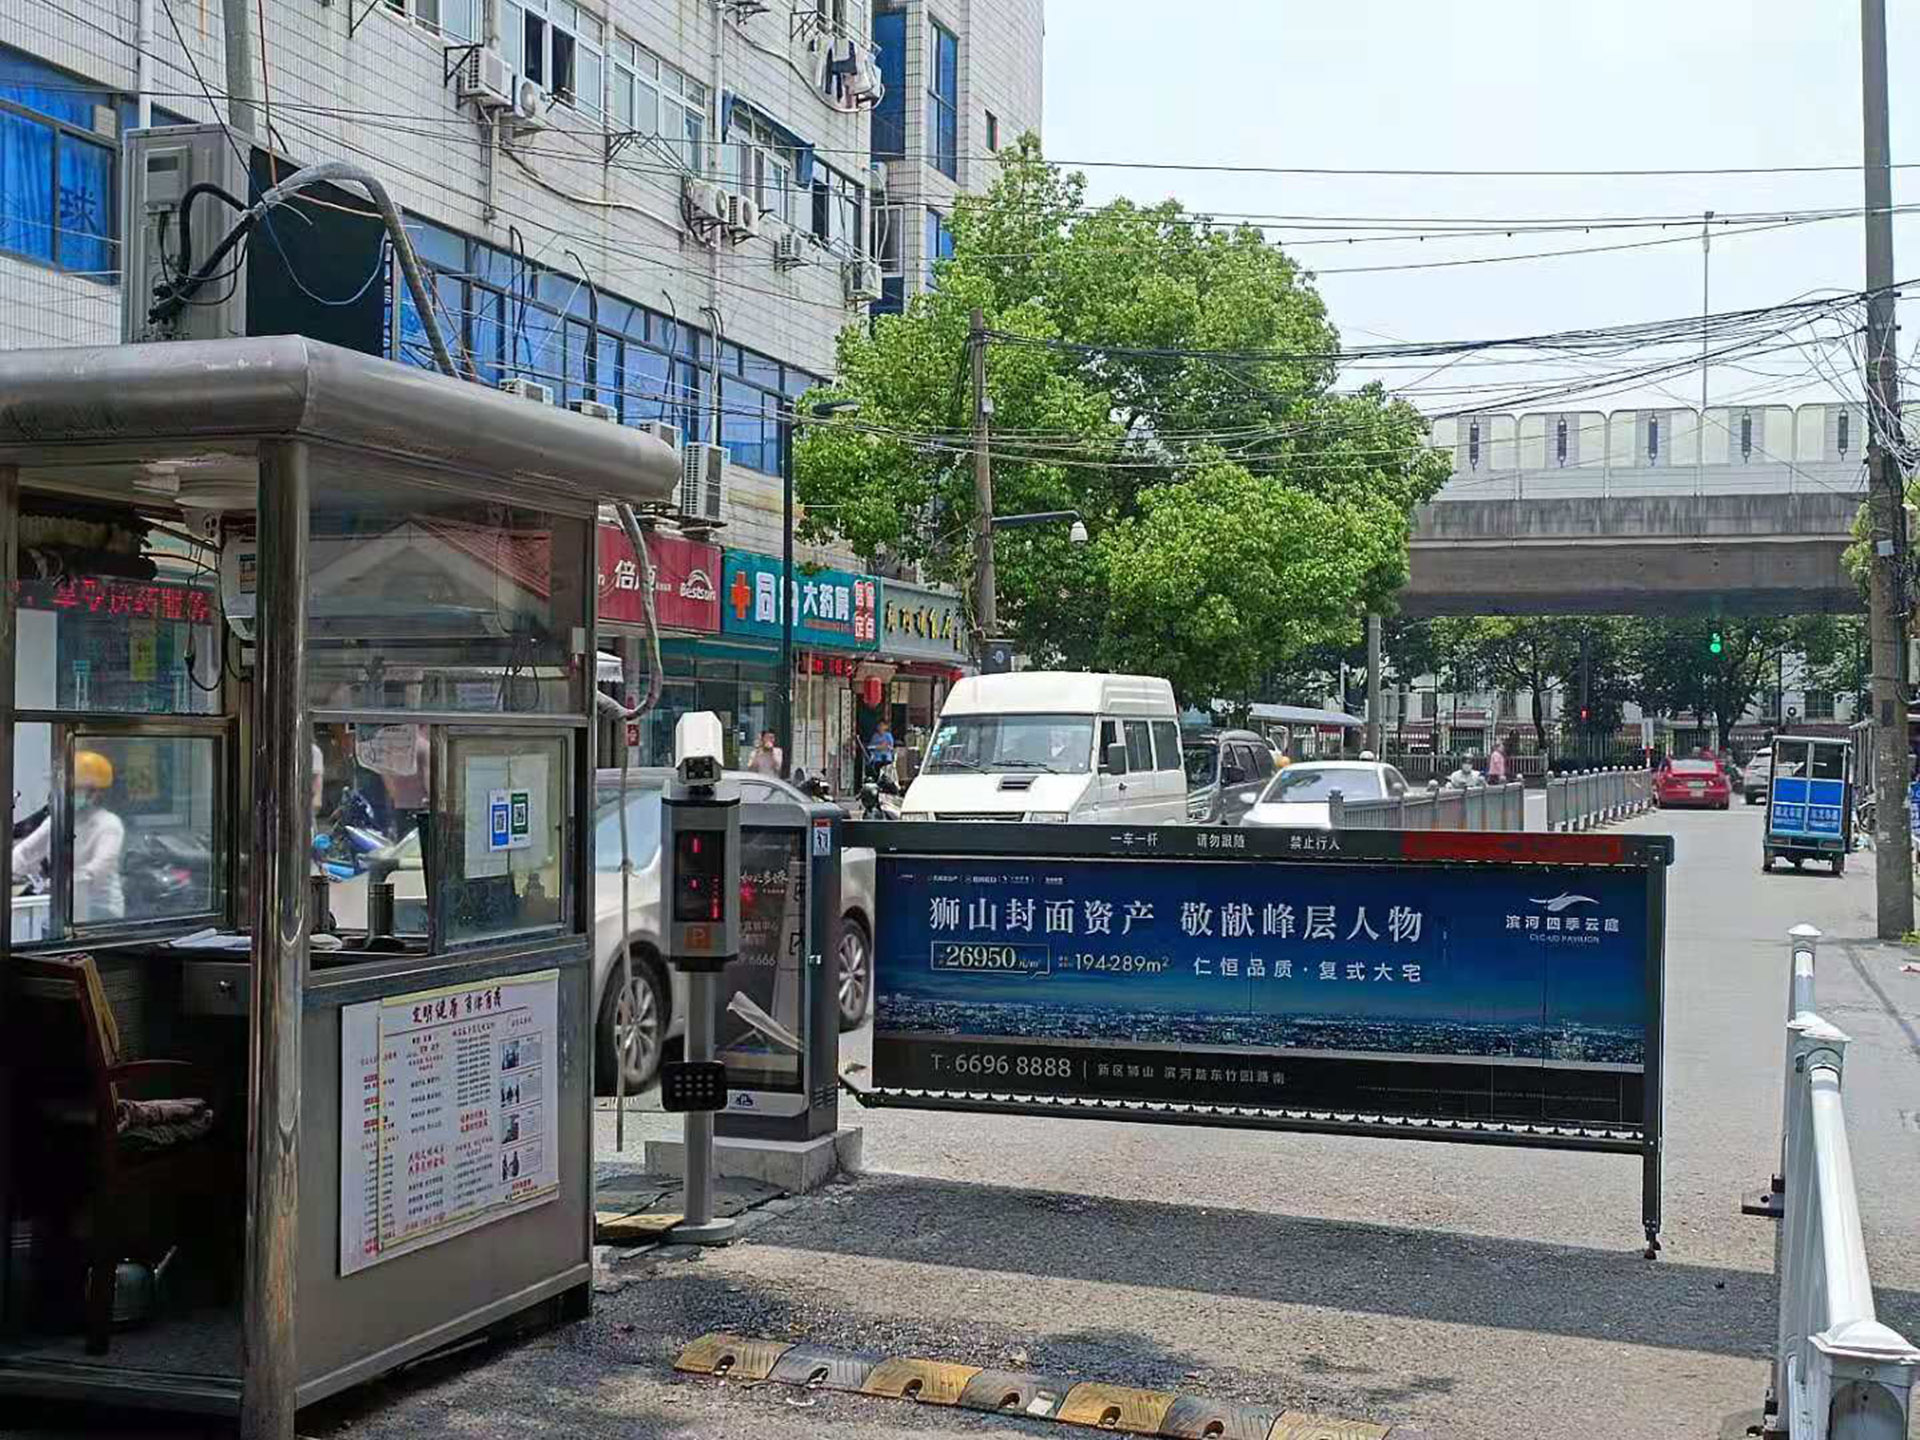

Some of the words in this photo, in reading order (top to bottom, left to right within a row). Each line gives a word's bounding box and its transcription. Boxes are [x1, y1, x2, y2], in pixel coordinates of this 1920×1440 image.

[1110, 832, 1158, 847] 一车一杆
[1197, 833, 1245, 849] 请勿跟随
[1290, 835, 1341, 850] 禁止行人
[929, 897, 1155, 935] 狮山封面资产
[1180, 902, 1423, 942] 敬献峰层人物
[1505, 914, 1620, 932] 滨河四季云庭
[946, 946, 1017, 968] 26950
[955, 1054, 1010, 1075] 6696
[1016, 1056, 1072, 1077] 8888
